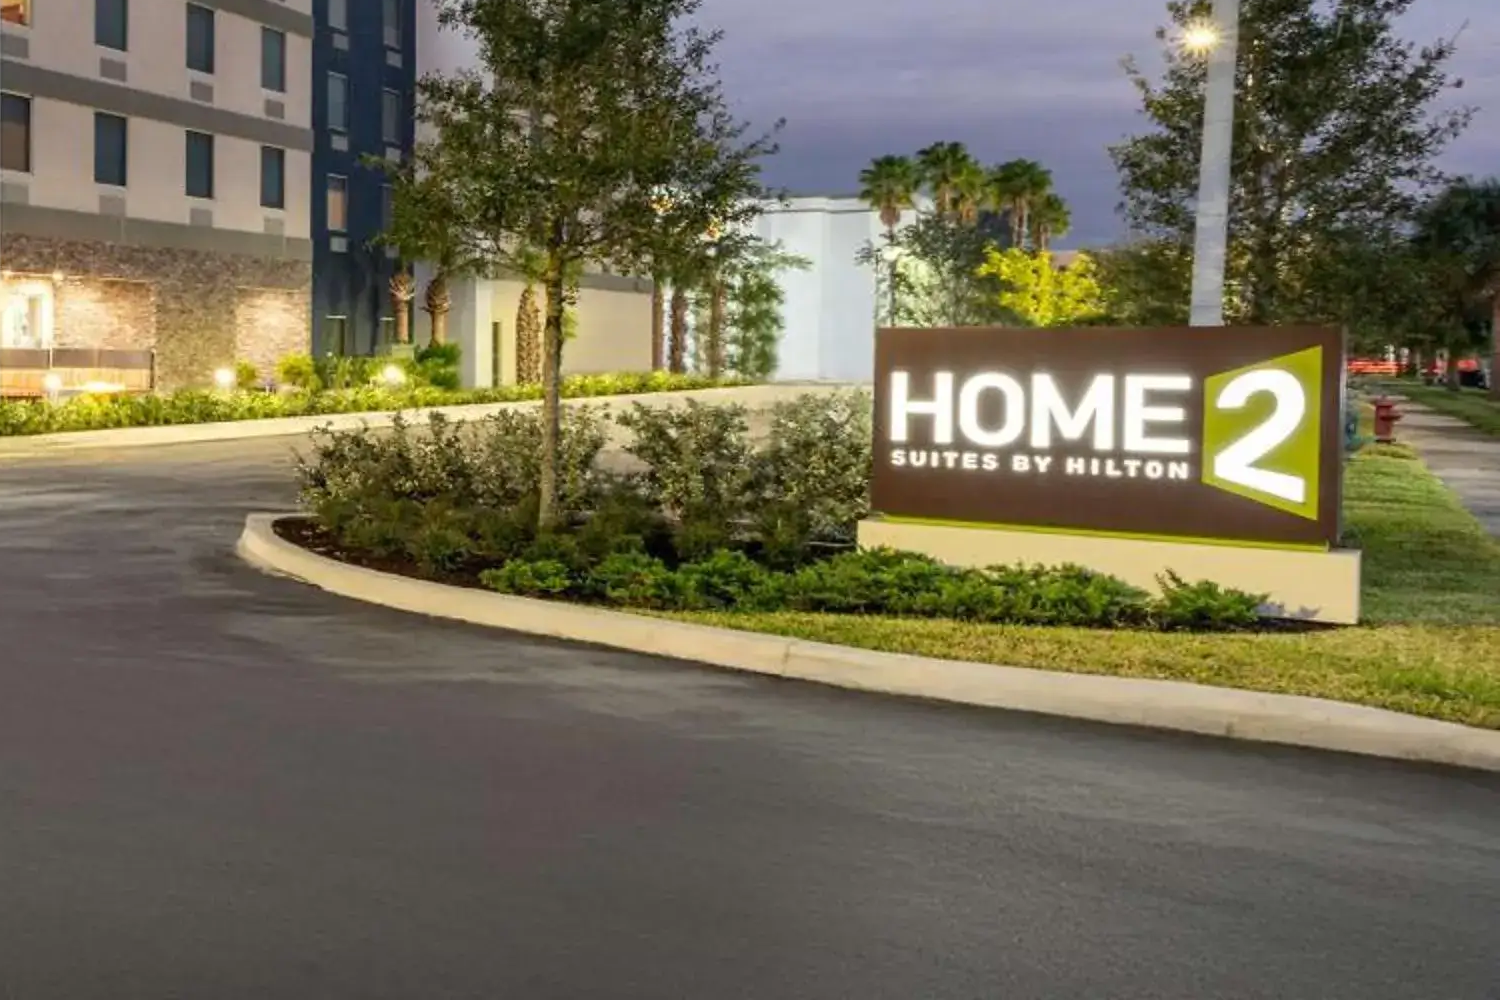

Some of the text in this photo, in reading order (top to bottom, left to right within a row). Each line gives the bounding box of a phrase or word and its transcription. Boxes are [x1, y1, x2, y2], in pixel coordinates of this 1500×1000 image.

[890, 369, 1306, 503] HOME 2
[891, 449, 1189, 481] SUITES BY HILTON
